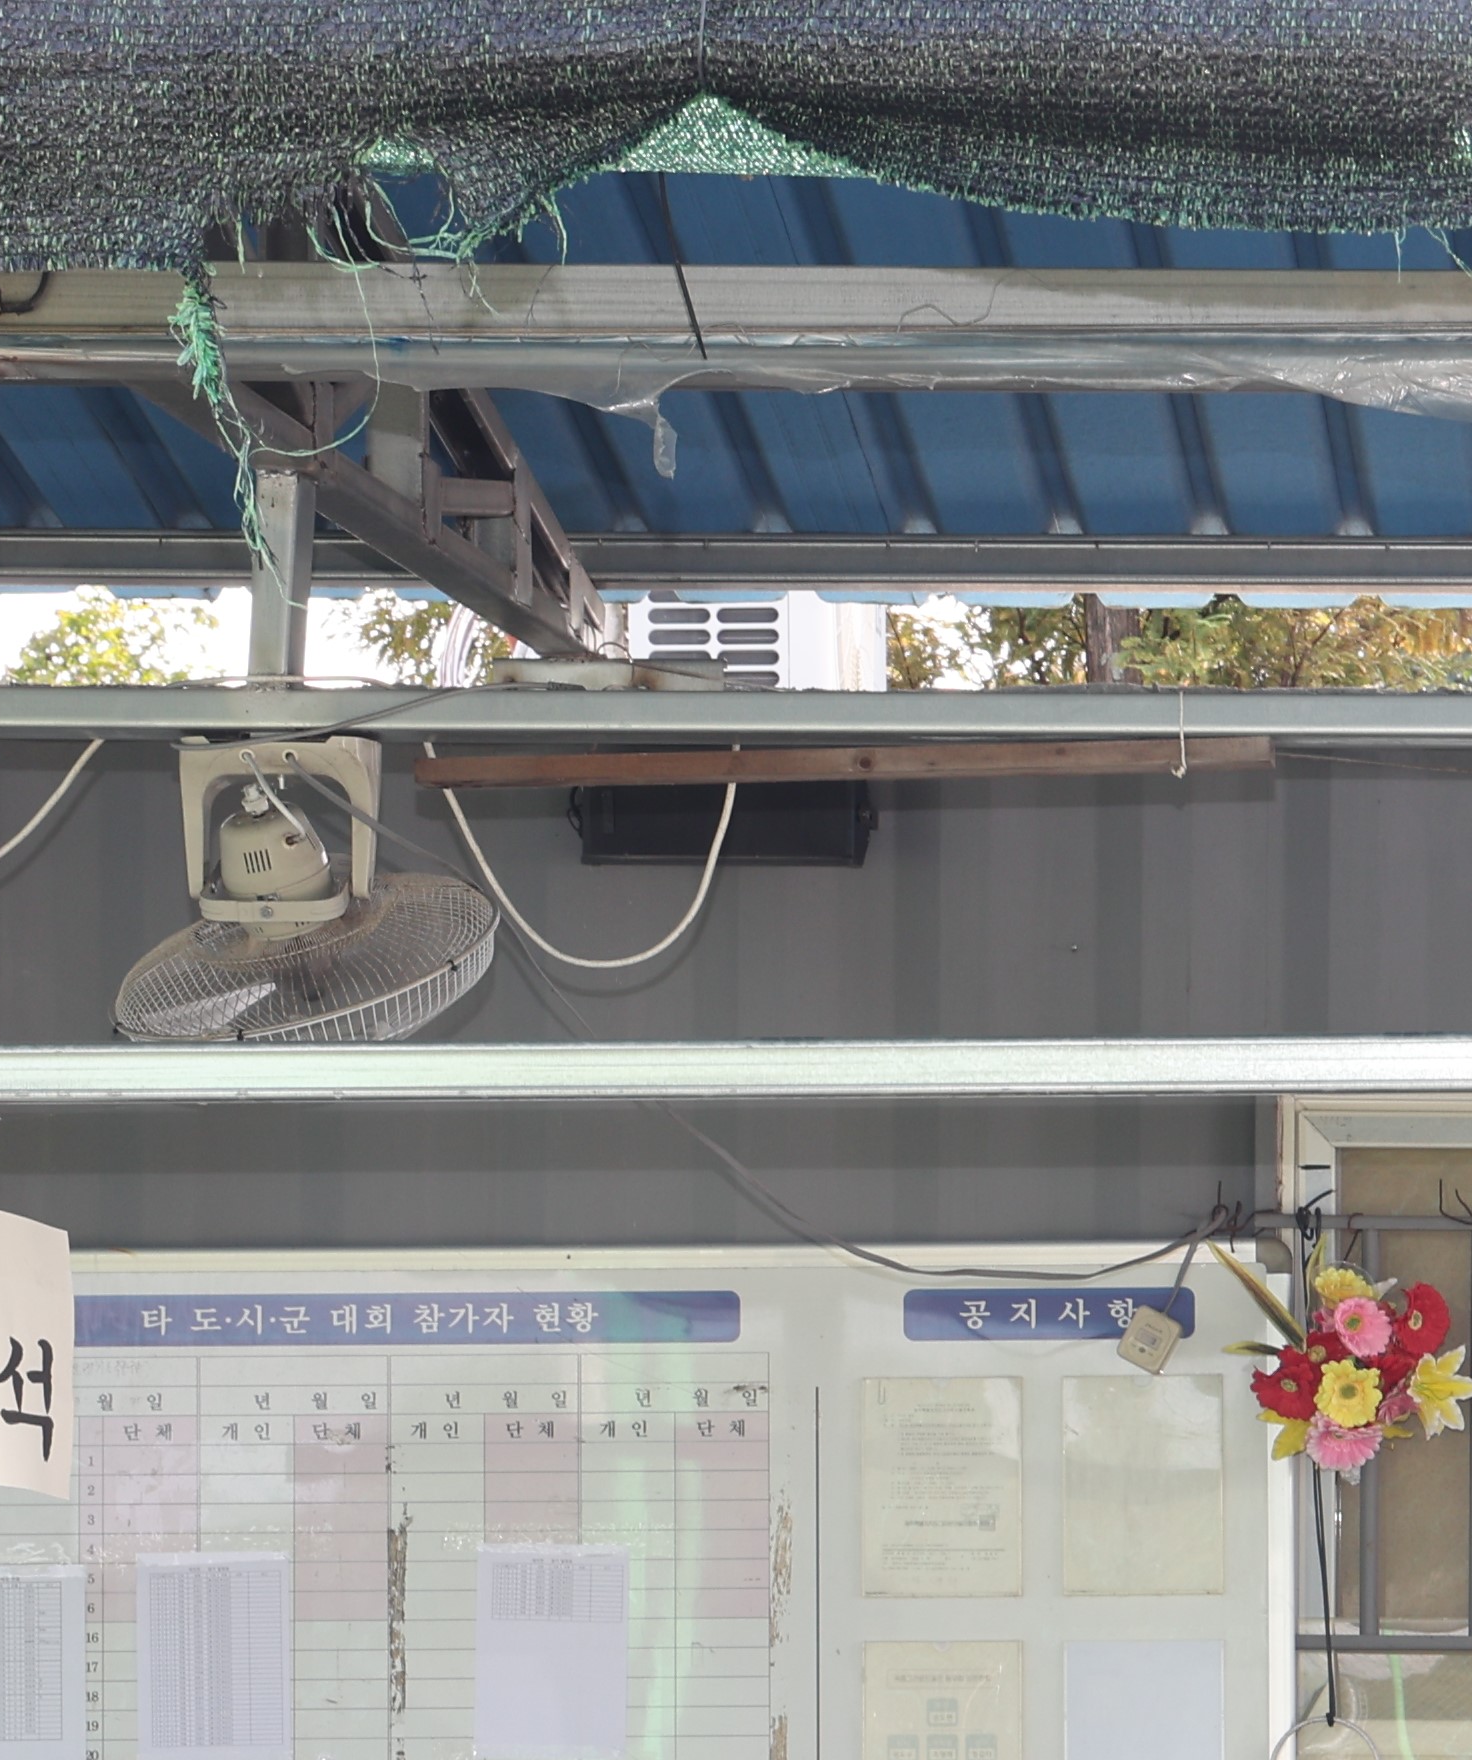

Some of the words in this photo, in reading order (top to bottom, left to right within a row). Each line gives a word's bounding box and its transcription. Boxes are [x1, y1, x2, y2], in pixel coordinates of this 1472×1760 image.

[141, 1305, 173, 1335] 타
[190, 1304, 311, 1335] 도·시·군
[331, 1304, 393, 1335] 대회
[414, 1303, 514, 1335] 참가자
[534, 1302, 599, 1334] 현황
[96, 1394, 114, 1412] 월
[146, 1393, 163, 1411] 일
[255, 1393, 272, 1411] 년
[312, 1392, 328, 1411] 월
[361, 1391, 378, 1409] 일
[445, 1390, 462, 1409] 년
[502, 1390, 519, 1409] 월
[551, 1389, 568, 1408] 일
[635, 1389, 652, 1408] 년
[692, 1388, 709, 1407] 월
[741, 1388, 759, 1408] 일
[87, 1455, 94, 1467] 1
[87, 1484, 95, 1497] 2
[86, 1514, 95, 1526] 3
[86, 1543, 95, 1556] 4
[86, 1573, 95, 1585] 5
[86, 1602, 95, 1614] 6
[85, 1632, 99, 1644] 16
[85, 1661, 99, 1673] 17
[85, 1691, 99, 1703] 18
[85, 1720, 99, 1732] 19
